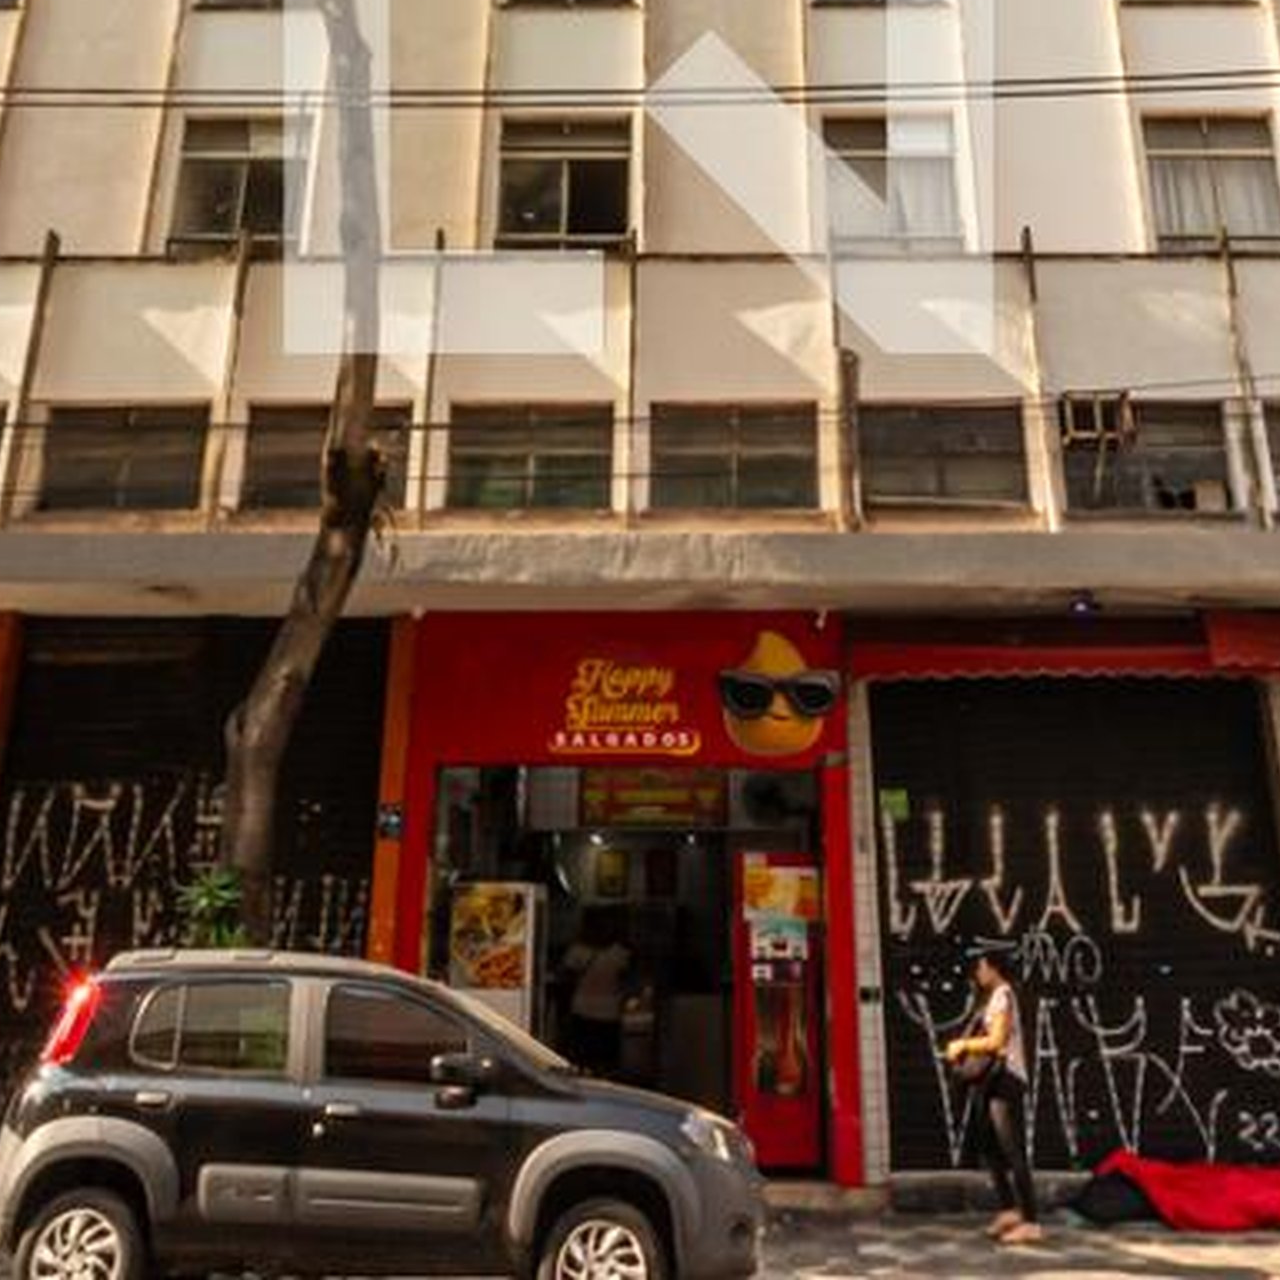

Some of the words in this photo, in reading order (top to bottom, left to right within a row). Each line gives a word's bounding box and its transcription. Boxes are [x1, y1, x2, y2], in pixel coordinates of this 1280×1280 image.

[571, 658, 675, 699] Happy
[565, 693, 680, 731] Summer
[554, 731, 690, 748] SALGADOS
